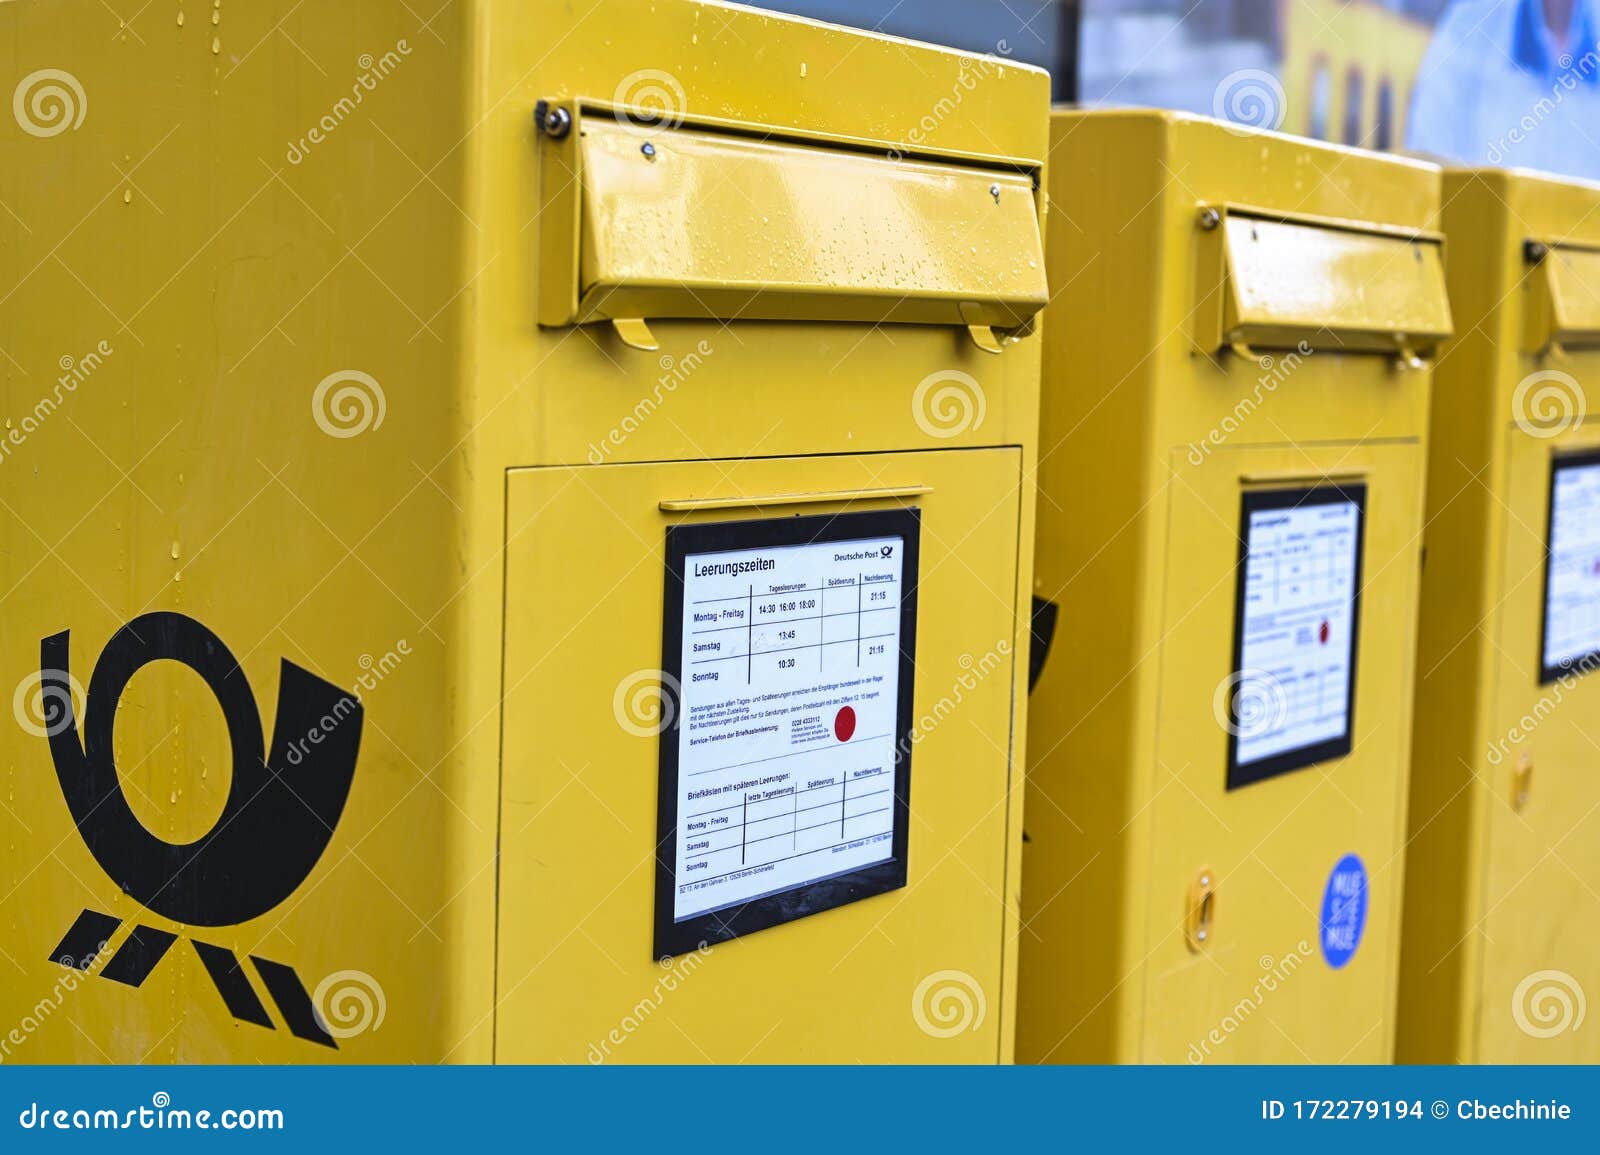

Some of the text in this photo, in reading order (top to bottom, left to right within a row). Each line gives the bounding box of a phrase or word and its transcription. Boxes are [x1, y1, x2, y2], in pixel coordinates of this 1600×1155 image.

[834, 550, 879, 562] Deutsche Post
[694, 557, 775, 577] Leerungszeiten
[870, 592, 886, 601] 21:15
[759, 600, 816, 614] 14:30 16:00 18:00
[694, 610, 718, 622] Montag
[723, 608, 744, 619] Freitag
[778, 630, 796, 640] 13:45
[693, 642, 720, 652] Samstag
[869, 645, 884, 655] 21:15
[778, 659, 795, 669] 10:30
[692, 672, 718, 682] Sonntag
[688, 786, 722, 800] Briefkästen
[722, 783, 732, 792] mit
[734, 779, 758, 793] späteren
[688, 820, 707, 831] Montag
[710, 815, 728, 826] Freitag
